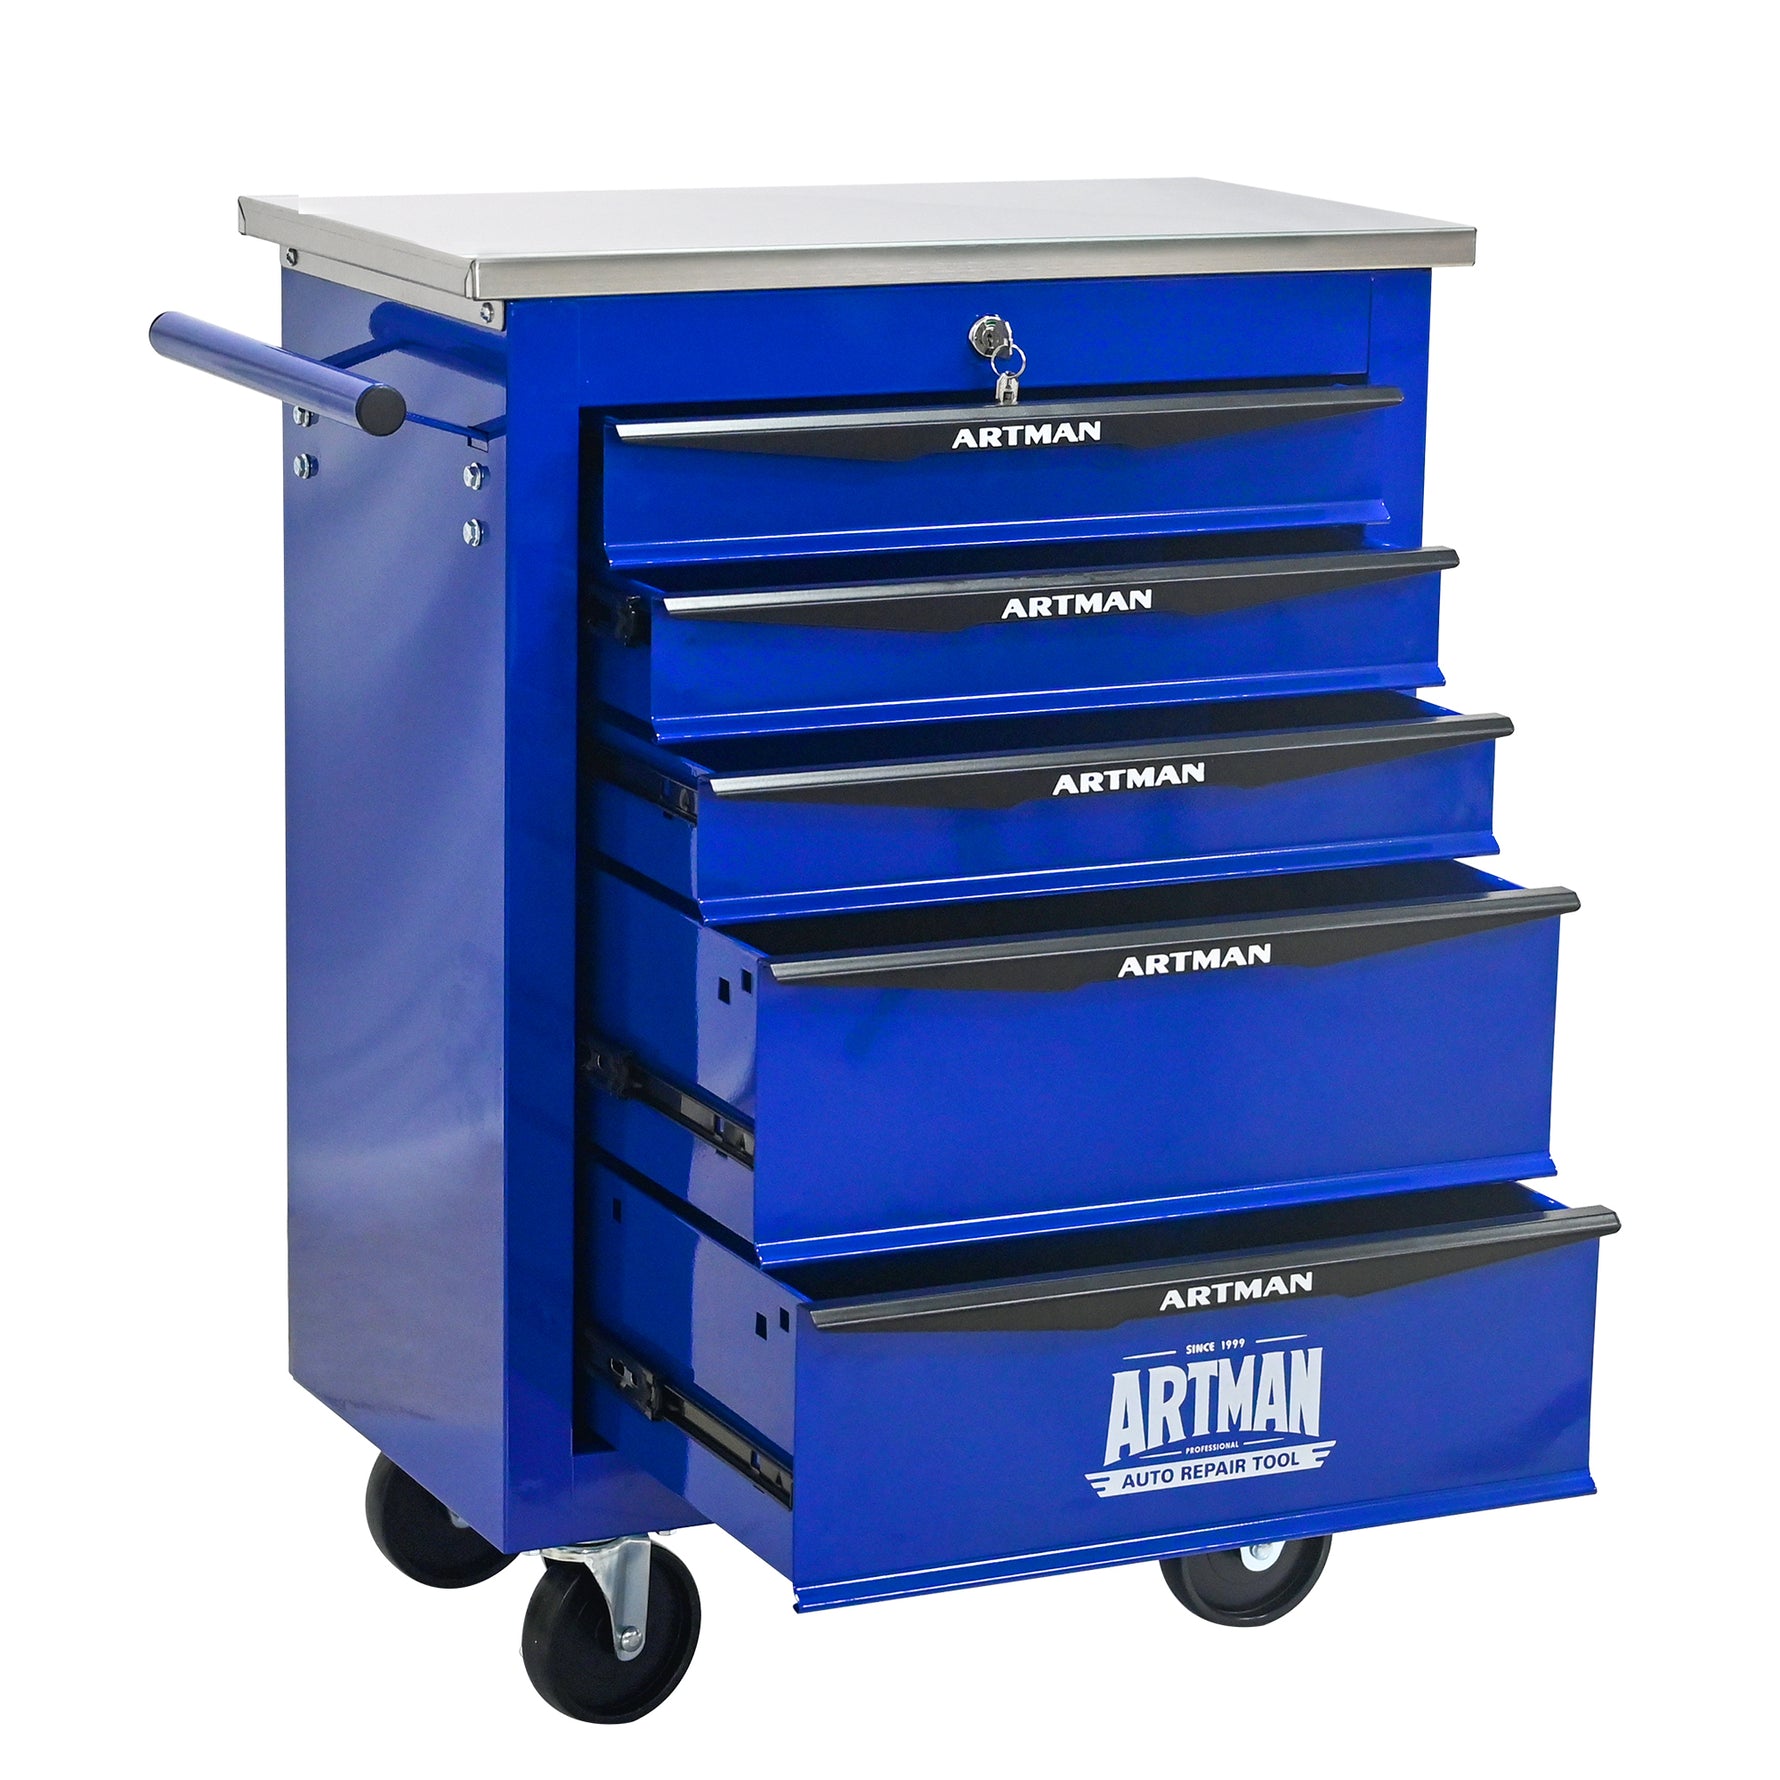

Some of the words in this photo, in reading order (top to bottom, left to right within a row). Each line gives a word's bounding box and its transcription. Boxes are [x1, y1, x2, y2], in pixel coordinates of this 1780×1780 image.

[951, 420, 1102, 449] ARTMAN
[1001, 588, 1153, 620] ARTMAN
[1052, 761, 1205, 796] ARTMAN
[1117, 942, 1272, 978] ARTMAN
[1159, 1271, 1313, 1312] ARTMAN
[1185, 1341, 1215, 1355] SINCE
[1221, 1338, 1246, 1351] 1999
[1103, 1346, 1324, 1467] ARTMAN
[1185, 1441, 1239, 1455] PROFESSIONAL
[1121, 1468, 1175, 1490] AUTO
[1180, 1458, 1247, 1482] REPAIR
[1252, 1451, 1300, 1470] TOOL
